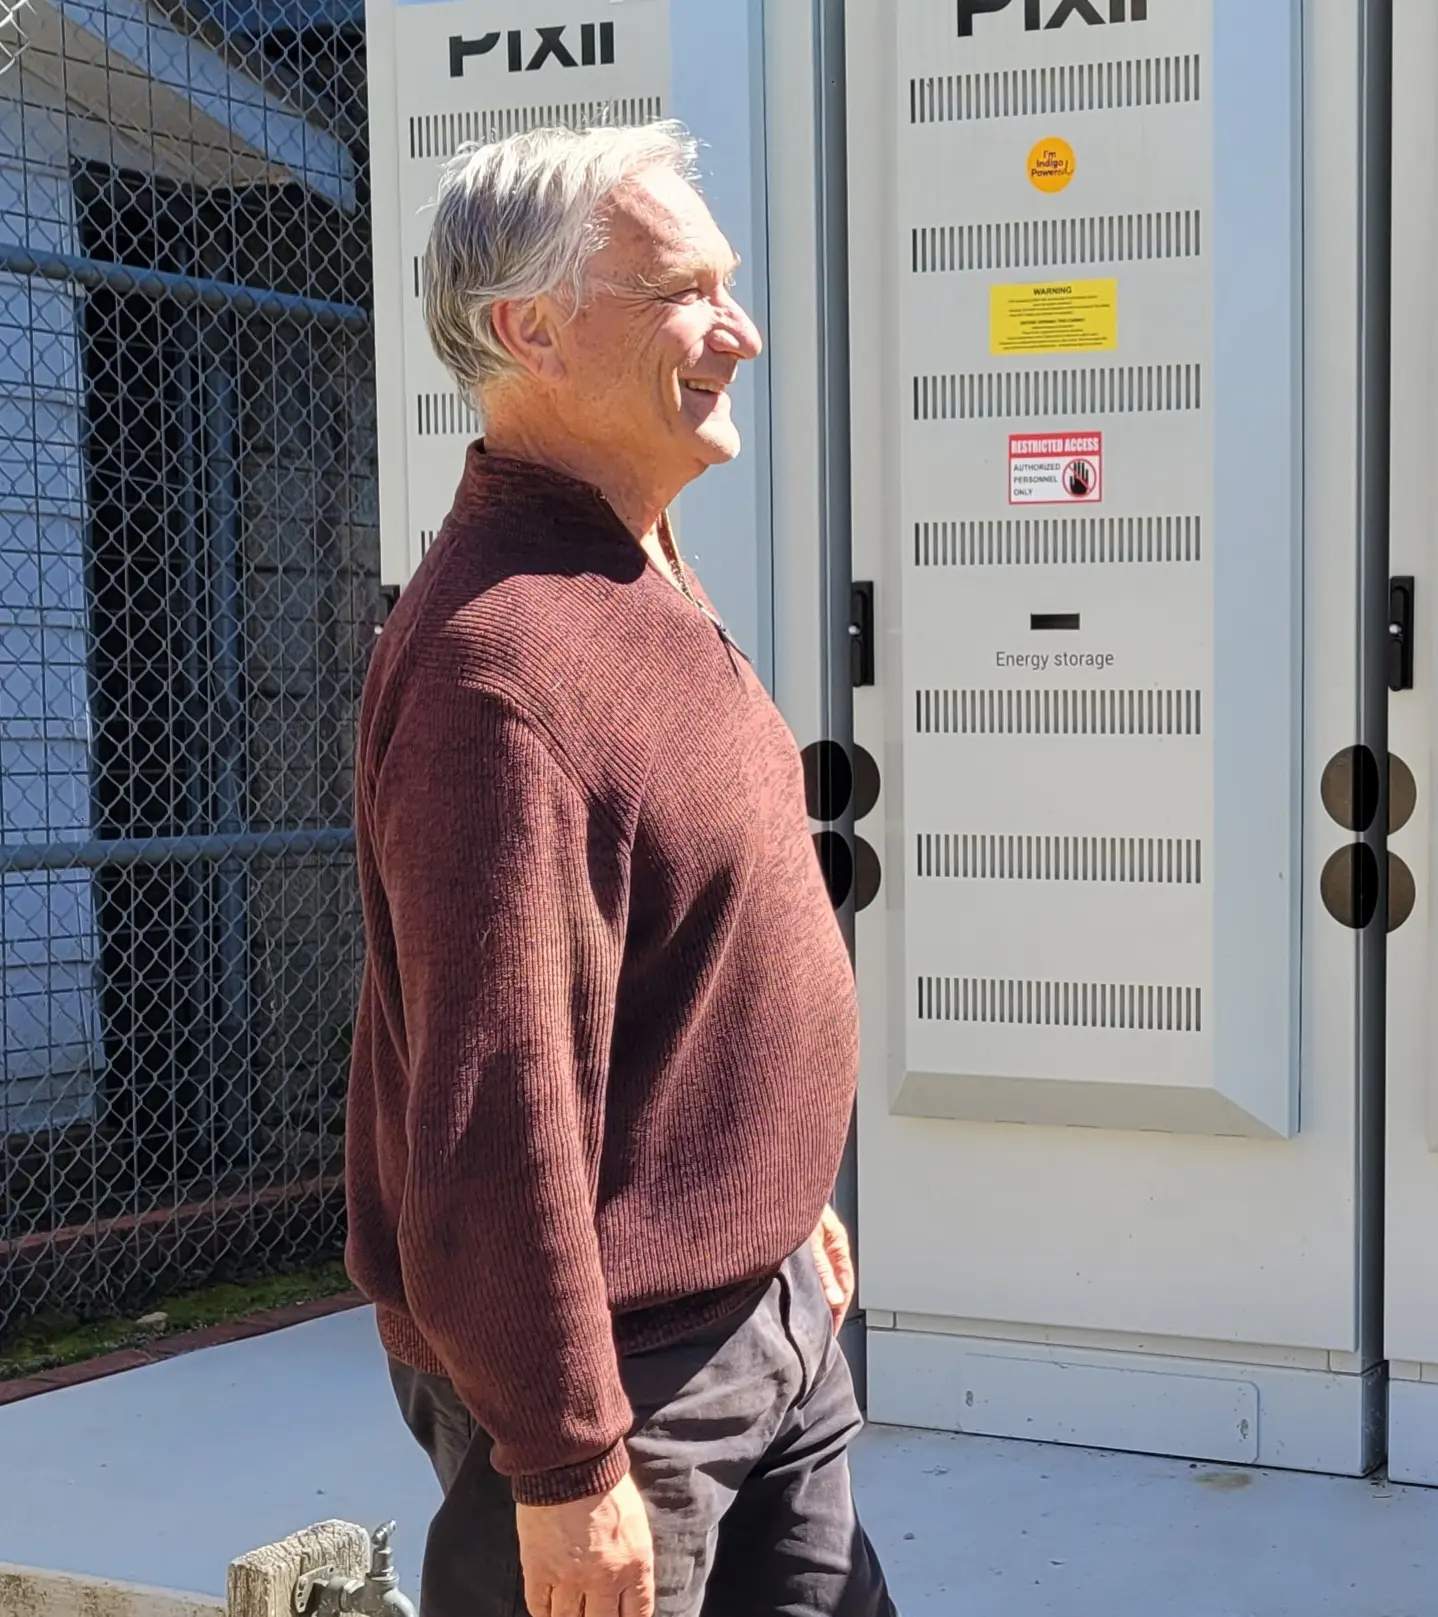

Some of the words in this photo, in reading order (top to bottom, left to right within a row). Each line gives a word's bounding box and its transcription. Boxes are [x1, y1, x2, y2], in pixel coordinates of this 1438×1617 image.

[1033, 286, 1072, 296] WARNING
[1011, 439, 1064, 454] RESTRICTED
[1064, 437, 1099, 452] ACCESS
[1013, 463, 1060, 472] AUTHORIZED
[1013, 475, 1058, 483] PERSONNEL
[996, 651, 1049, 671] Energy
[1054, 652, 1114, 670] storage
